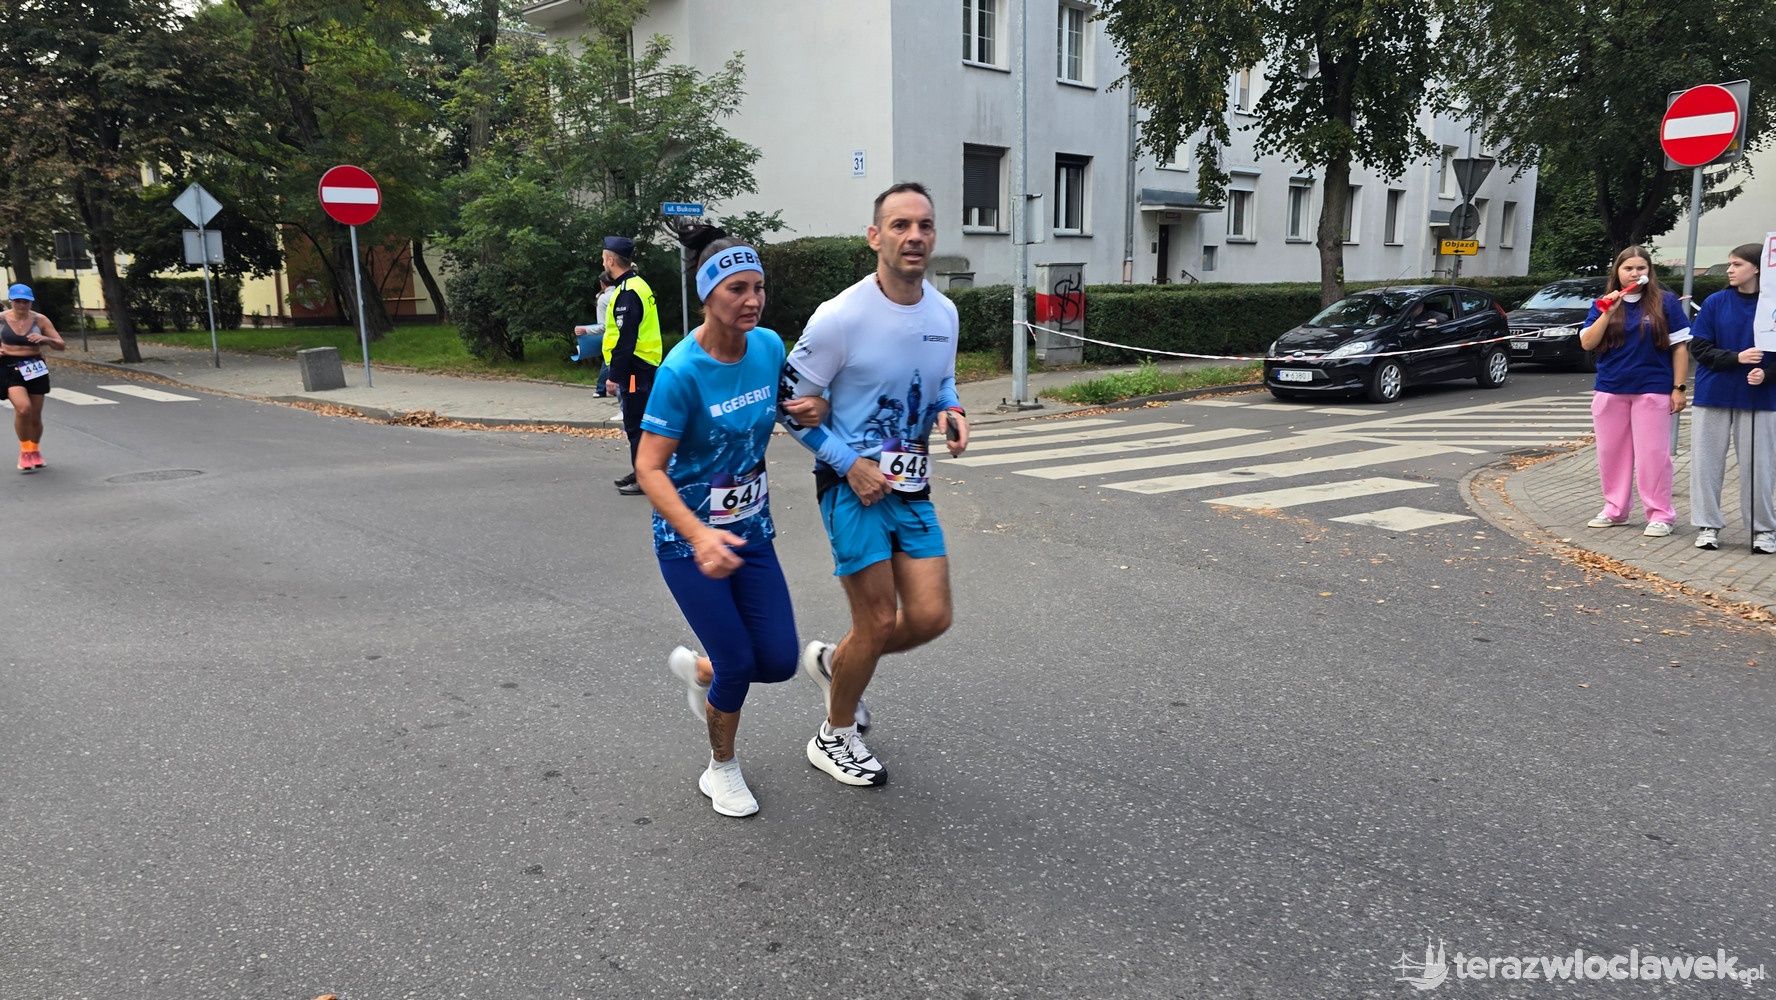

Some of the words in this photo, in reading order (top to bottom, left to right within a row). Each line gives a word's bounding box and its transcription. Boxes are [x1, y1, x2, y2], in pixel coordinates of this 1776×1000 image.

[854, 157, 864, 171] 31
[25, 362, 43, 373] 444
[721, 385, 771, 413] GEBERIT
[890, 454, 928, 477] 648
